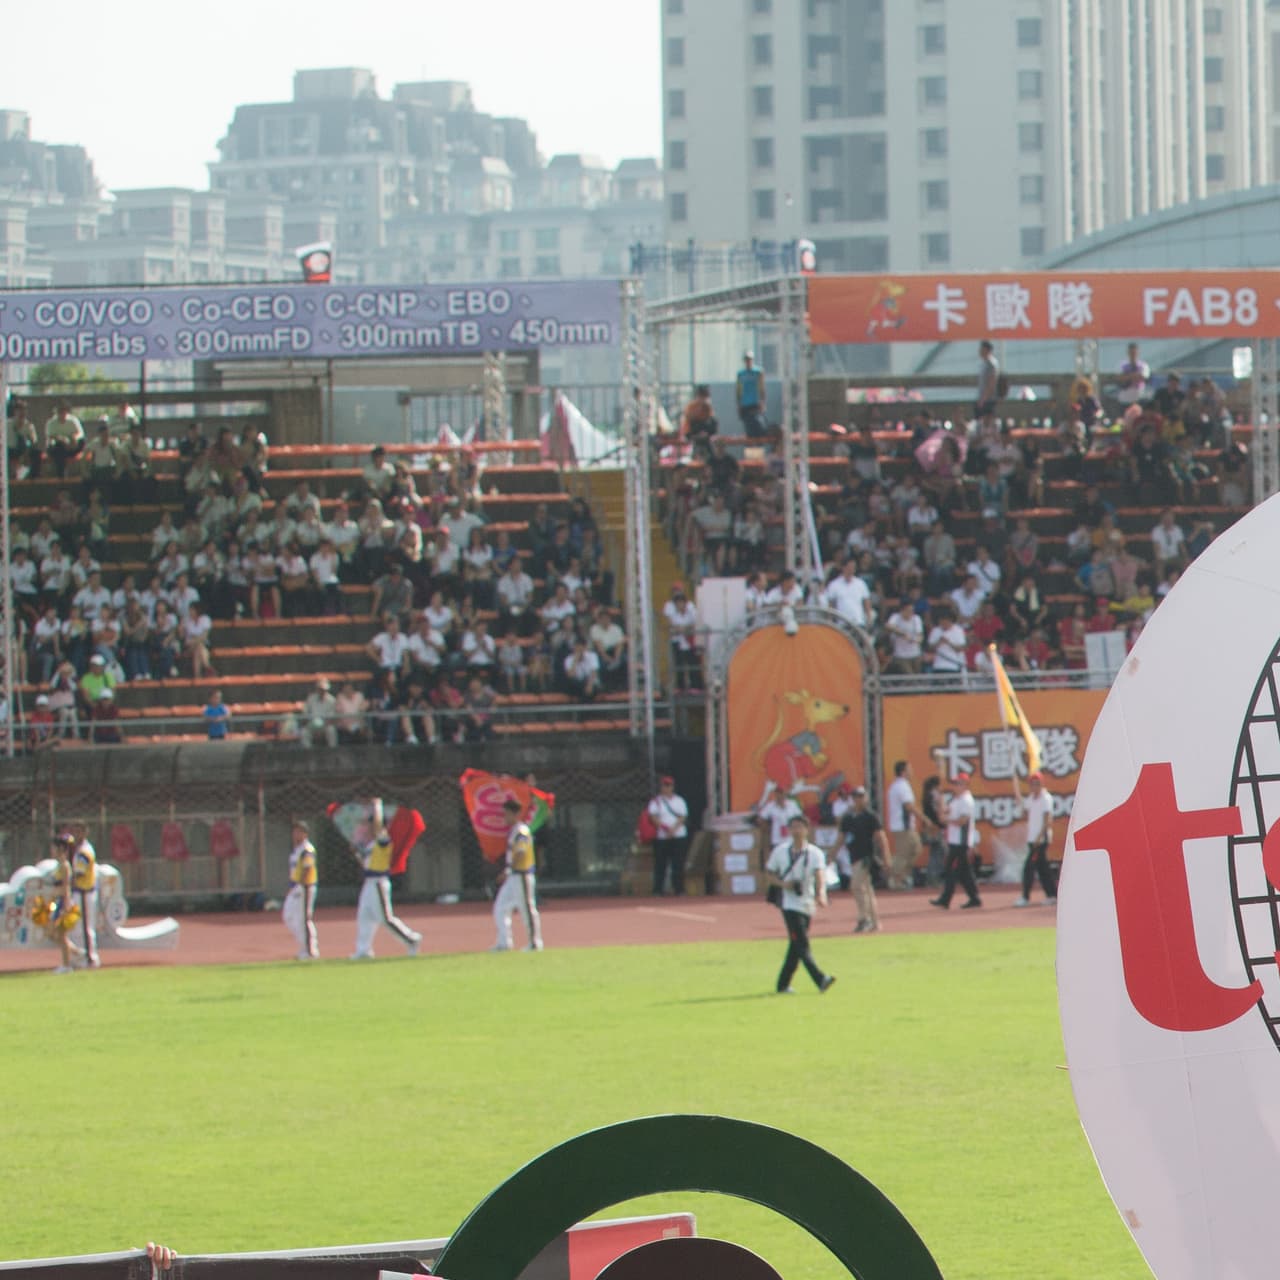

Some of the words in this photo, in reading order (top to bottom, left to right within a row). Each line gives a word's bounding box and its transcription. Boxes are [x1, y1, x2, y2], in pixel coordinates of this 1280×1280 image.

[447, 289, 512, 317] EBO
[922, 281, 1094, 332] 卡歐隊
[1142, 287, 1258, 326] FAB8
